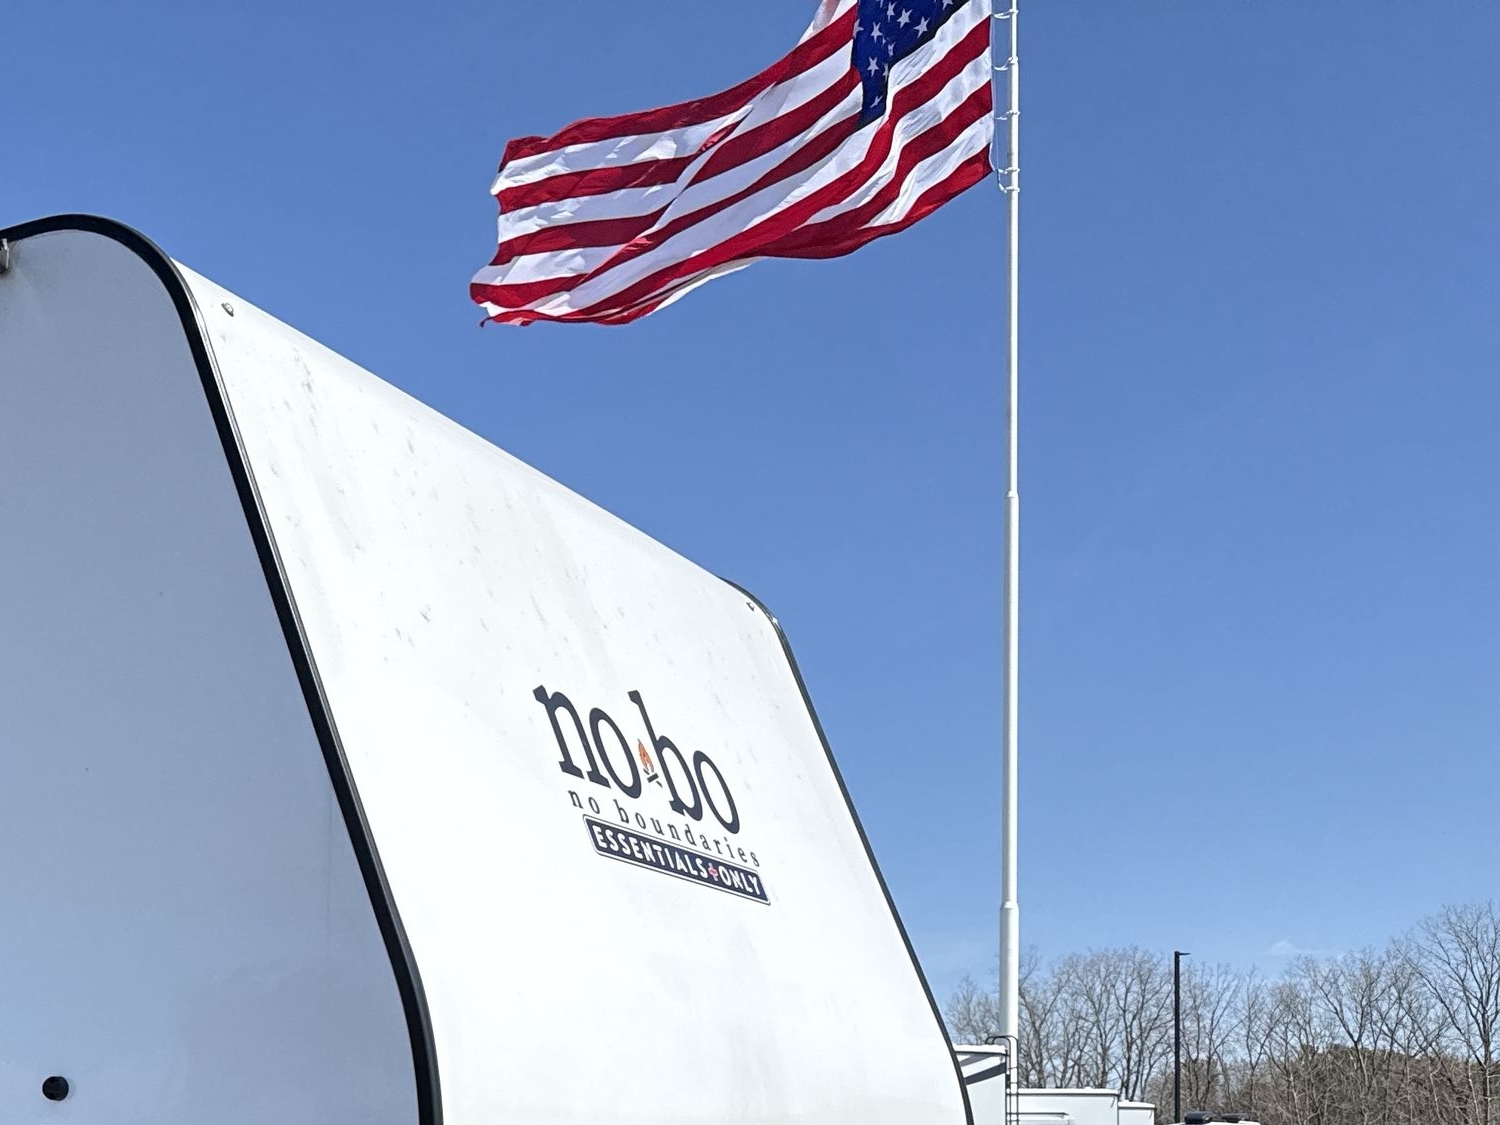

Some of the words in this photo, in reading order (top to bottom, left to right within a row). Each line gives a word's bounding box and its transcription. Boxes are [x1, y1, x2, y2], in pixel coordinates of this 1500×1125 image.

[567, 789, 601, 815] no
[613, 798, 760, 868] boundaries
[591, 824, 709, 879] ESSENTIALS
[717, 868, 762, 896] ONLY
